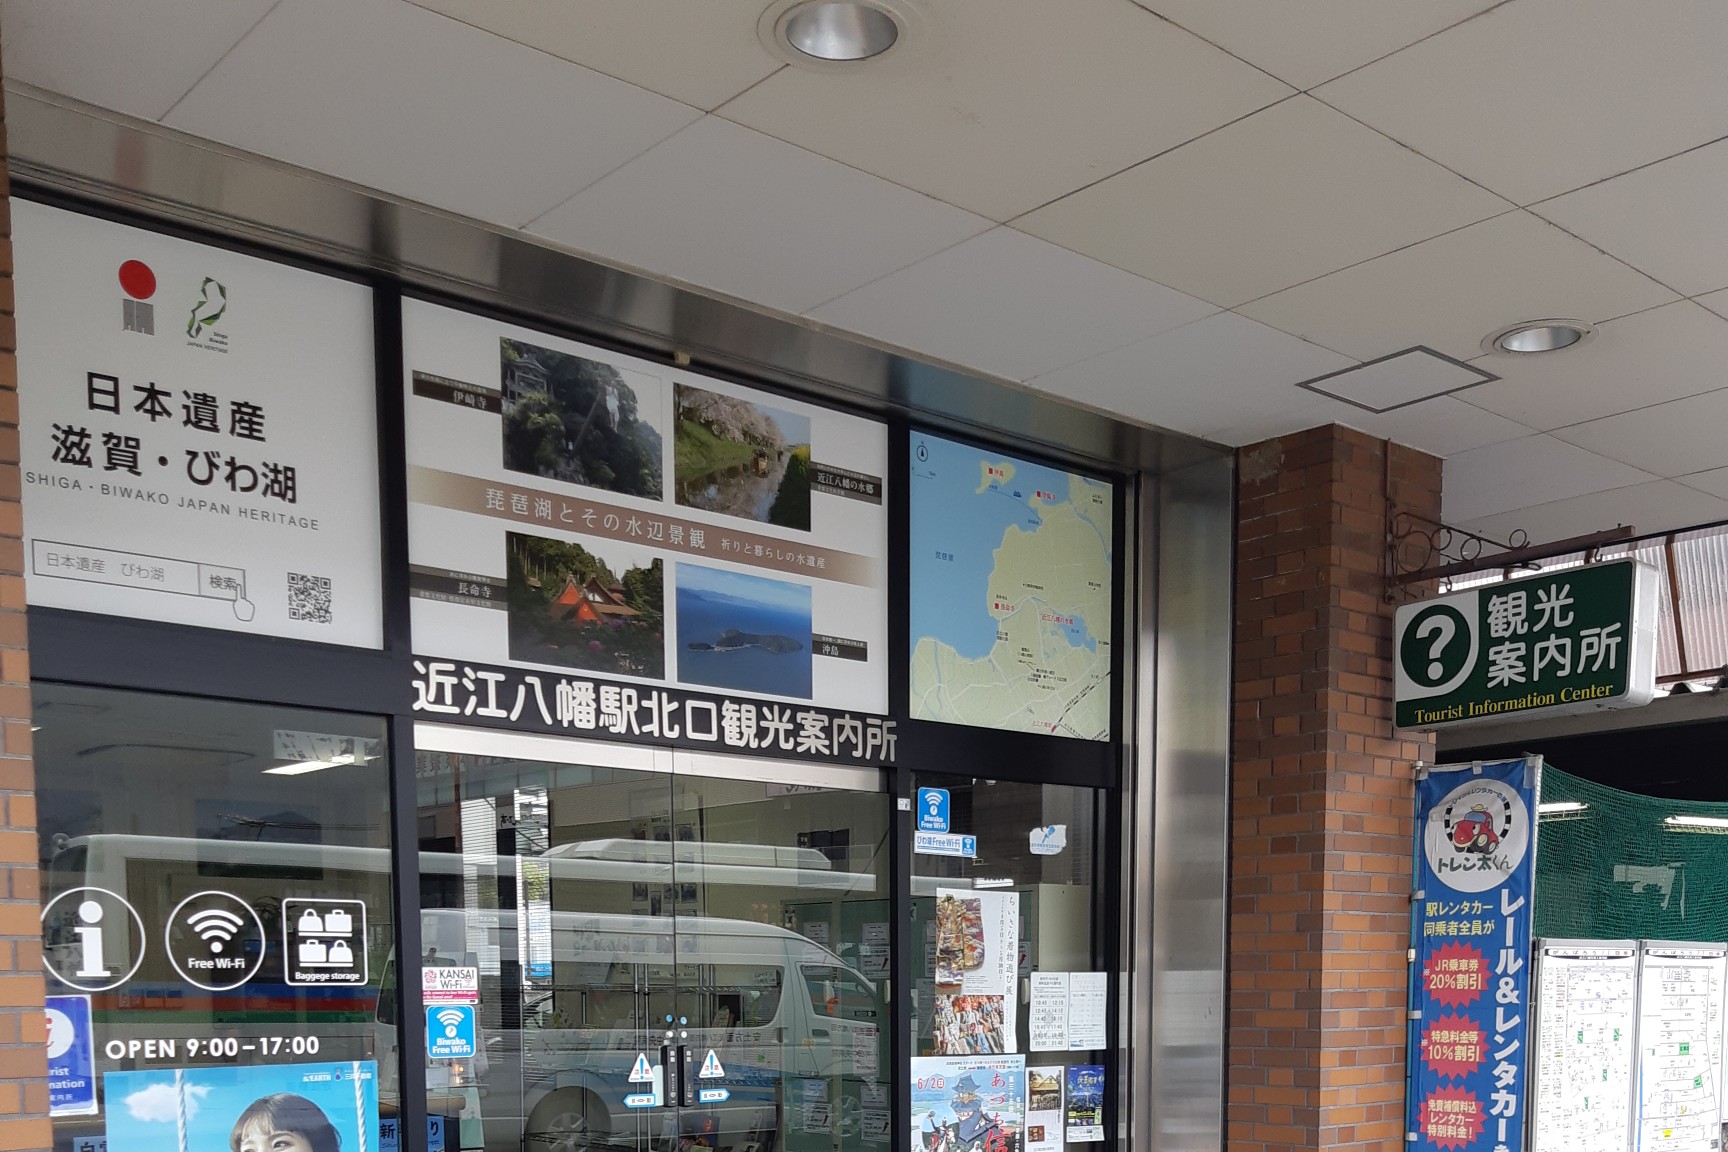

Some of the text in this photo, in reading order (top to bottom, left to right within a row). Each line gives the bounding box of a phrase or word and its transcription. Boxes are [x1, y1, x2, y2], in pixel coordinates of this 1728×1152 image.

[87, 371, 266, 442] 日本遺産
[50, 423, 298, 504] 滋賀・びわ湖
[816, 471, 874, 494] 近江八幡の水郷
[177, 496, 230, 516] JAPAN
[238, 506, 320, 531] HERITAGE
[485, 487, 827, 570] 琵琶湖とその水辺景観 祈りと暮らしの水遺産
[46, 551, 165, 583] 日本遺産 びわ湖
[208, 573, 237, 593] 検索
[458, 582, 493, 599] 長命寺
[1486, 583, 1575, 639] 観光
[822, 643, 839, 656] 沖島
[1486, 621, 1623, 690] 案内所
[411, 660, 898, 763] 近江八幡駅北口観光案内所
[1414, 683, 1614, 724] Tourist Information Center
[920, 821, 933, 829] Free
[1437, 854, 1514, 874] トレン太くん
[1425, 900, 1494, 917] 駅レンタカー
[1423, 919, 1495, 937] 同乗者全員が
[188, 957, 246, 970] Free Wi-Fi
[1434, 958, 1479, 973] JR乗車券
[331, 972, 361, 981] storage
[439, 969, 475, 980] KANSAI
[1429, 972, 1482, 990] 20%割引
[440, 979, 462, 989] Wi-Fi
[436, 1038, 467, 1046] Biwako
[1430, 1030, 1479, 1044] 特急料金等
[105, 1038, 176, 1060] OPEN
[432, 1045, 471, 1054] Free Wi-Fi
[1427, 1044, 1480, 1062] 10%割引
[1427, 1099, 1477, 1114] 免責補償料込
[1430, 1113, 1474, 1125] レンタカー
[380, 1123, 396, 1140] 新
